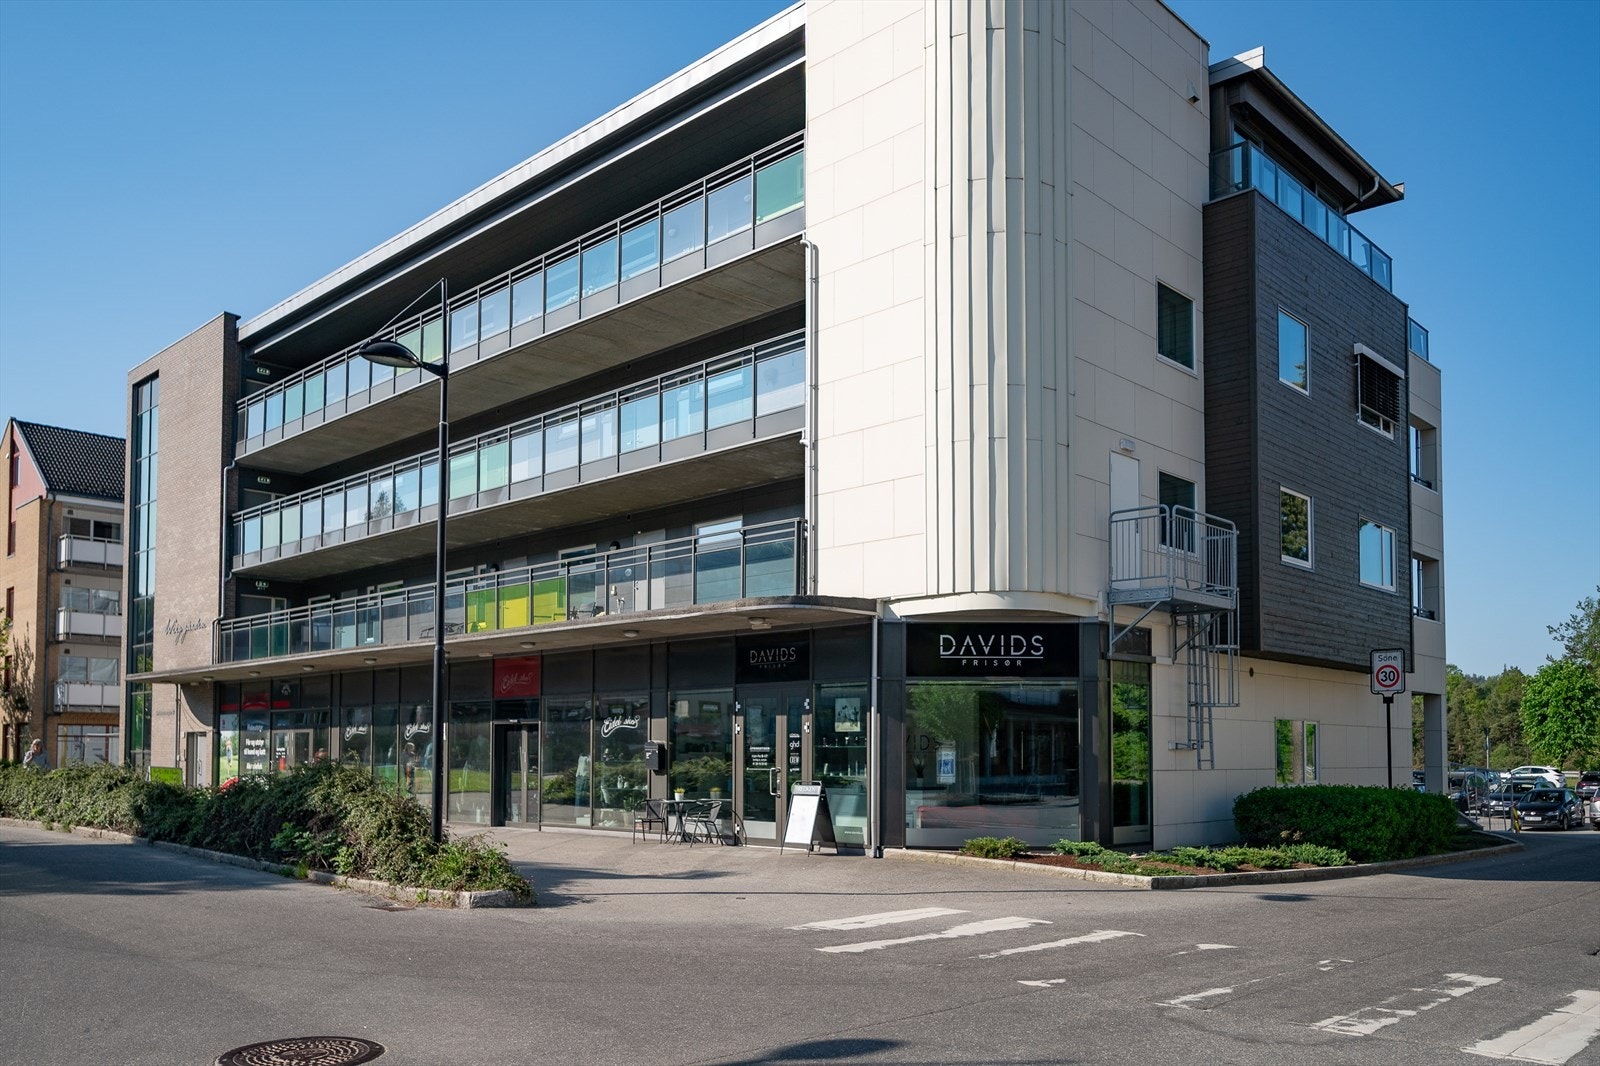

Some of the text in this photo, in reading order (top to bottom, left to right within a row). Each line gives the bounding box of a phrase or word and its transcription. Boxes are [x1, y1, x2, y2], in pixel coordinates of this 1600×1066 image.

[940, 634, 1044, 656] DAVIDS
[750, 647, 796, 663] DAVIDS
[1378, 654, 1398, 662] Sone
[961, 659, 1022, 667] FRISØR
[1380, 670, 1396, 682] 30
[789, 740, 800, 750] ghd
